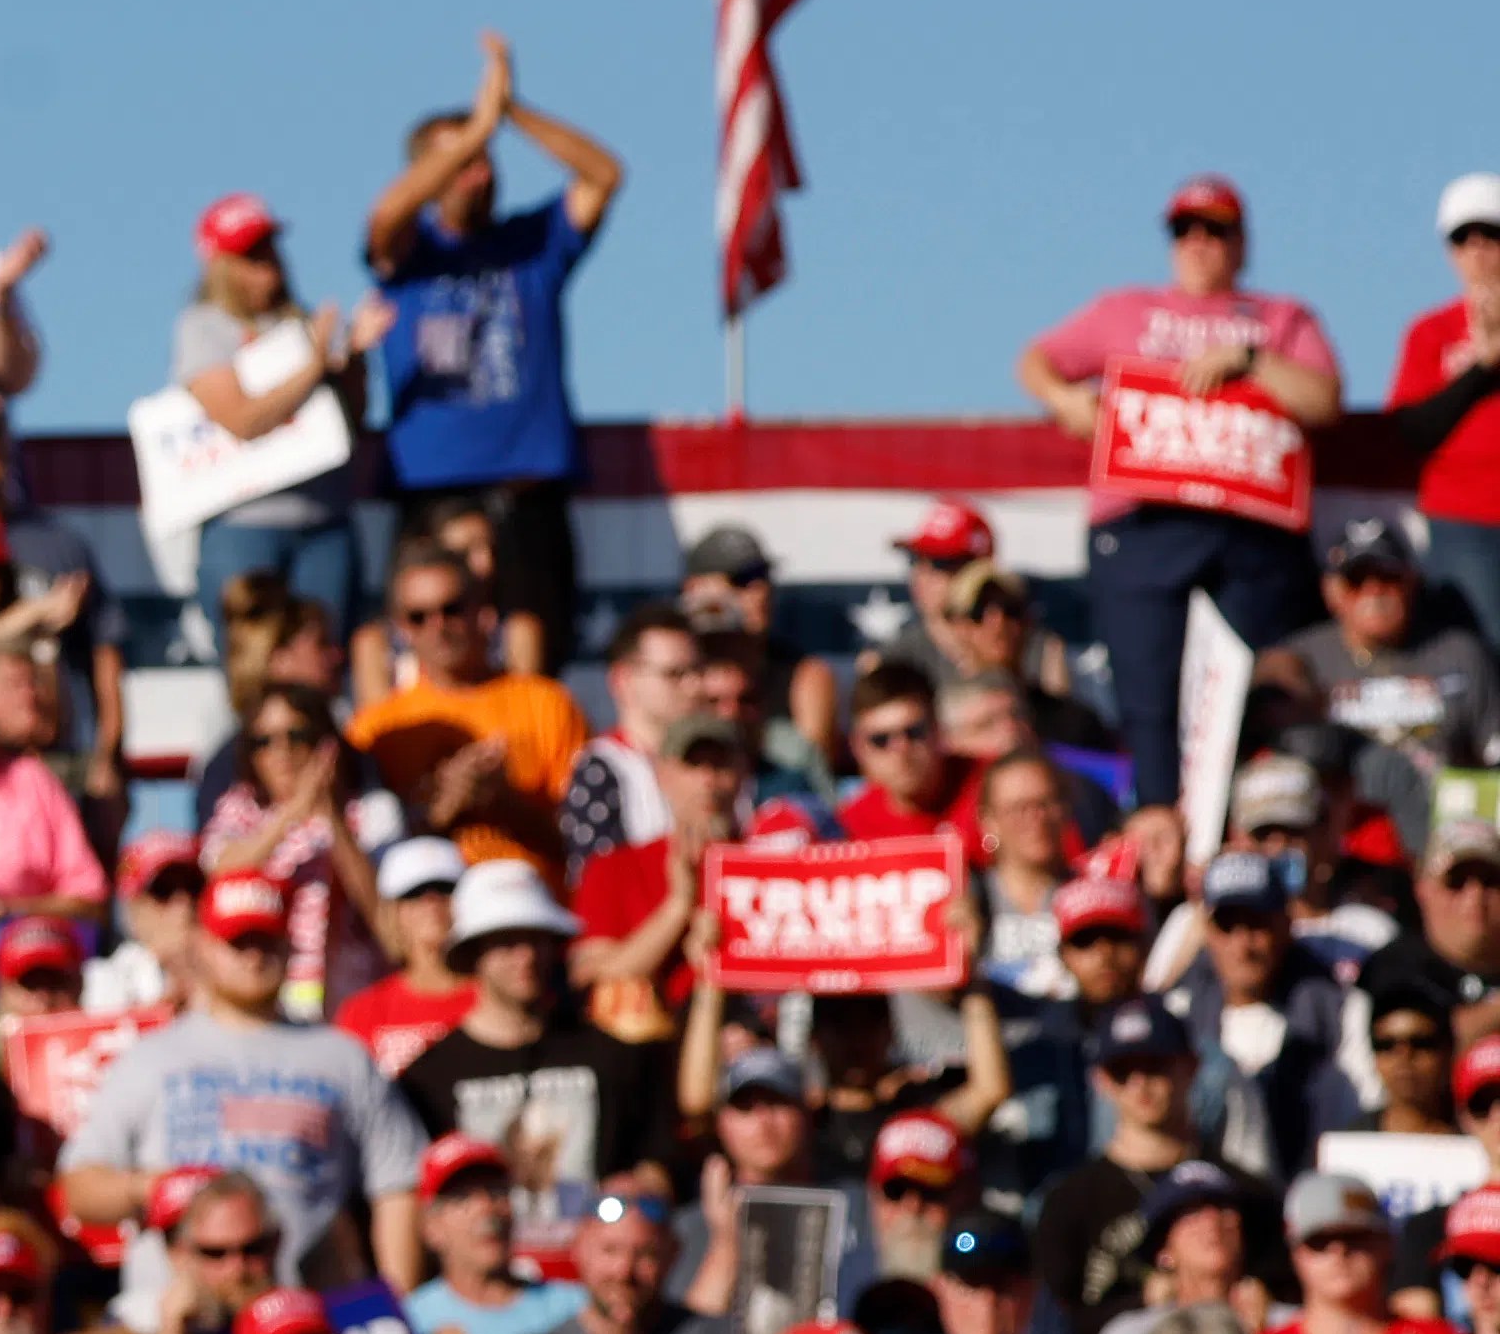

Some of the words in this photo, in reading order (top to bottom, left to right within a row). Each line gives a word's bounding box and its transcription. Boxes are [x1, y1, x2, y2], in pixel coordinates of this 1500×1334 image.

[1112, 387, 1302, 452] TRUMP
[719, 866, 951, 919] TRUMP
[742, 908, 926, 953] VANCE
